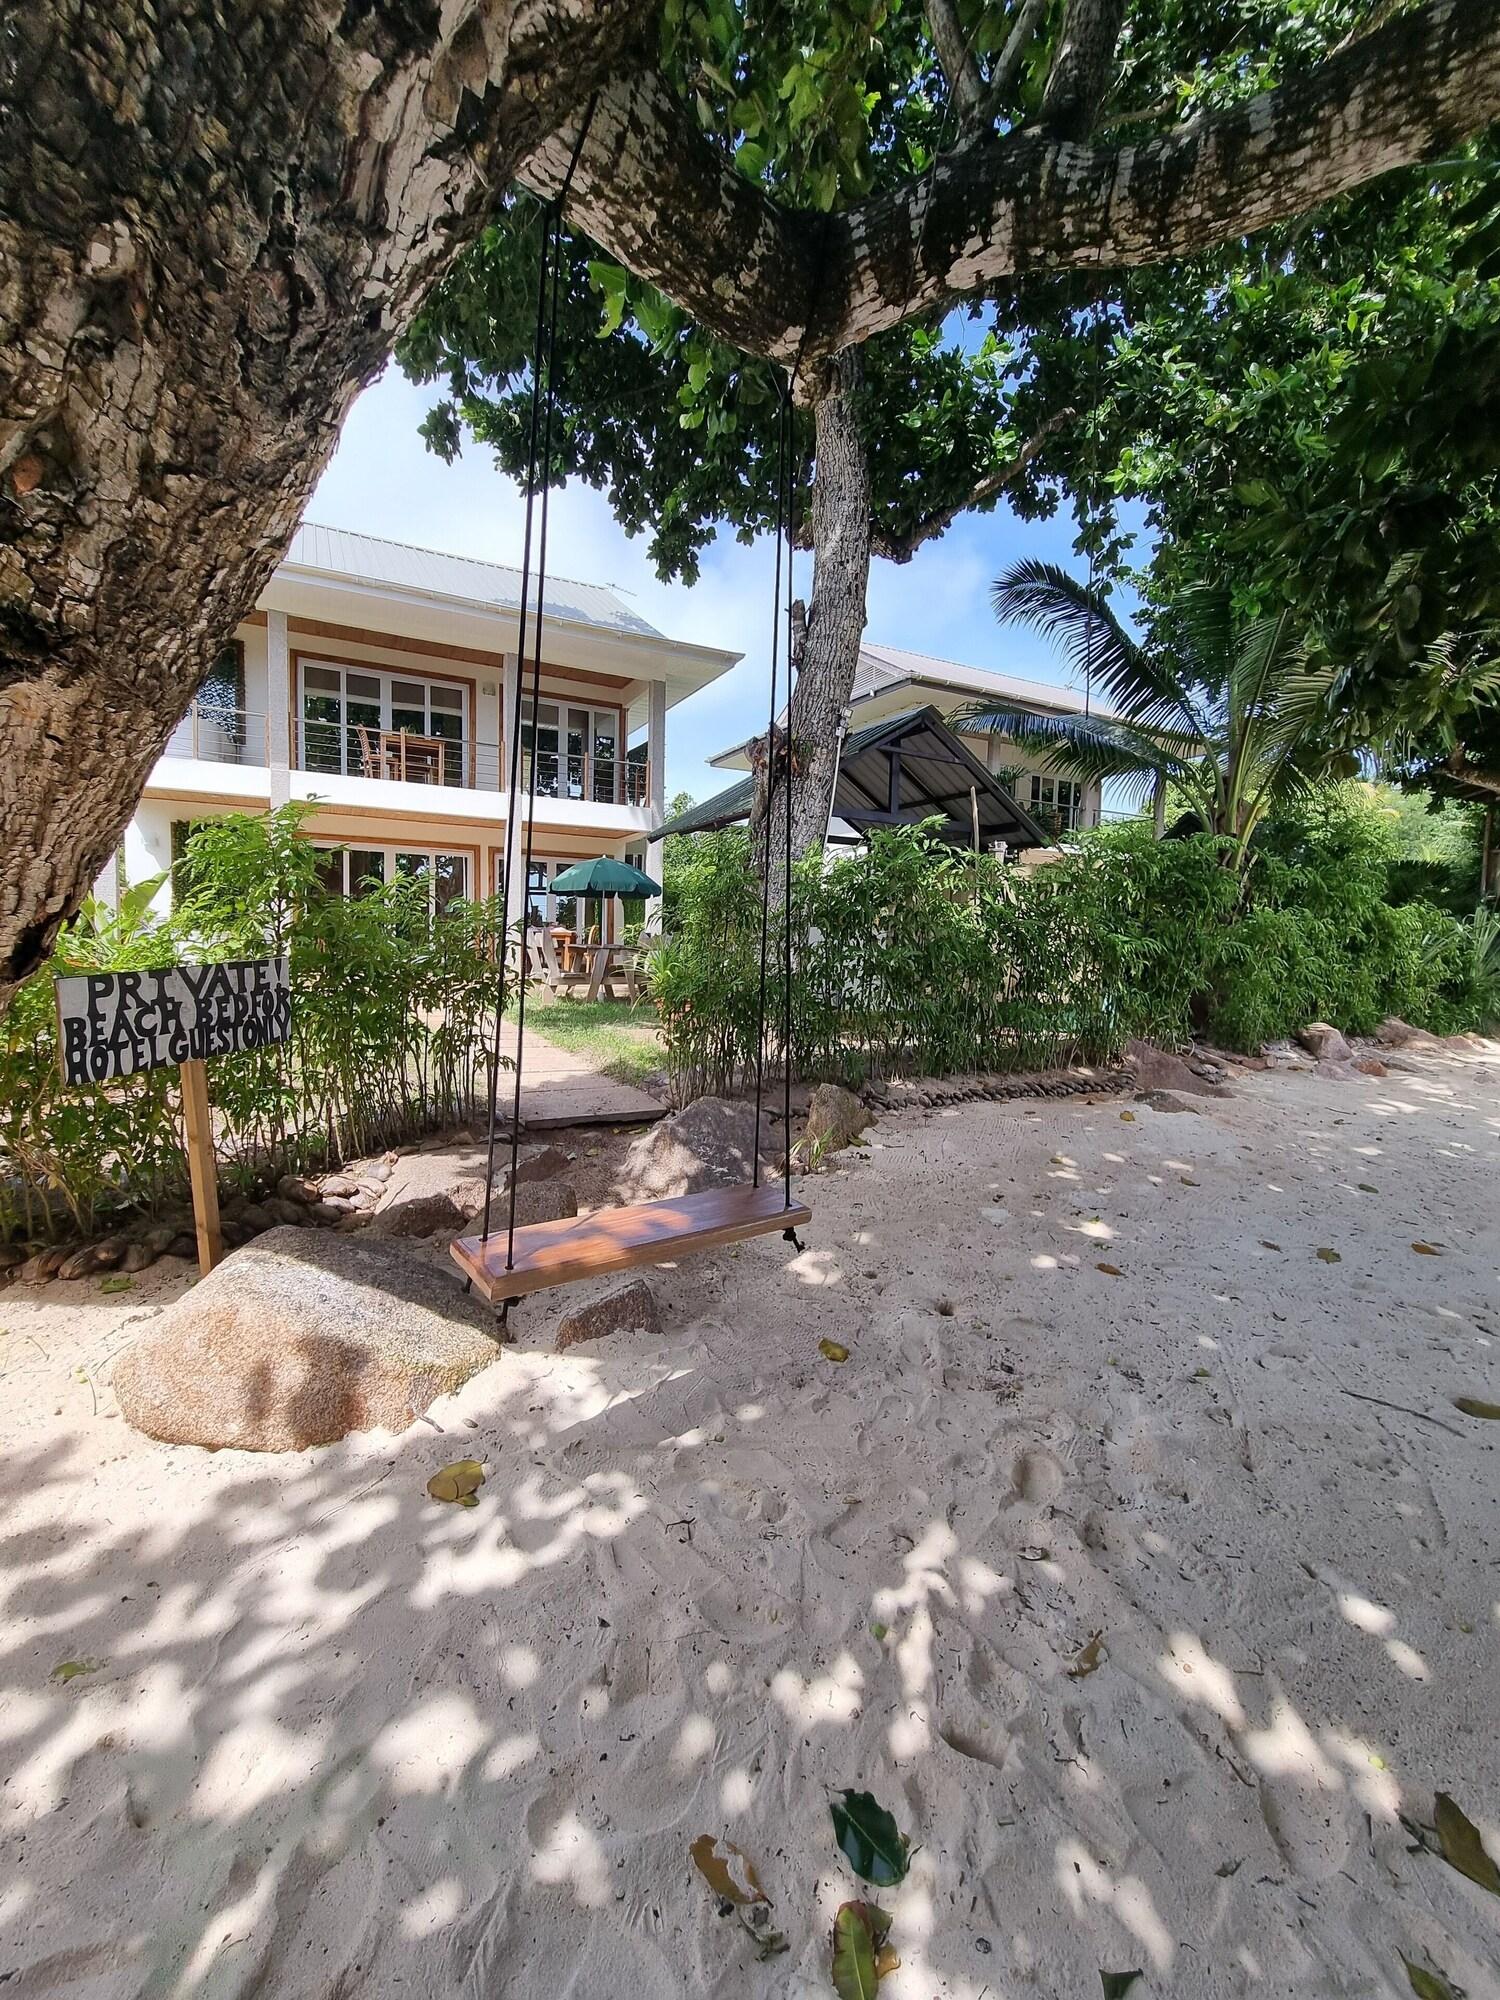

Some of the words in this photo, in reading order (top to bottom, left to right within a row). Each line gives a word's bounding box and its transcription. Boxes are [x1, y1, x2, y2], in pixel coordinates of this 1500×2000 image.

[63, 997, 186, 1052] BEACH
[194, 993, 249, 1027] BED
[249, 984, 290, 1018] FOR
[87, 959, 282, 1015] PRIVATE!
[64, 1034, 167, 1086] HOTEL
[168, 1022, 243, 1063] GUEST
[241, 1013, 291, 1048] ONLY
